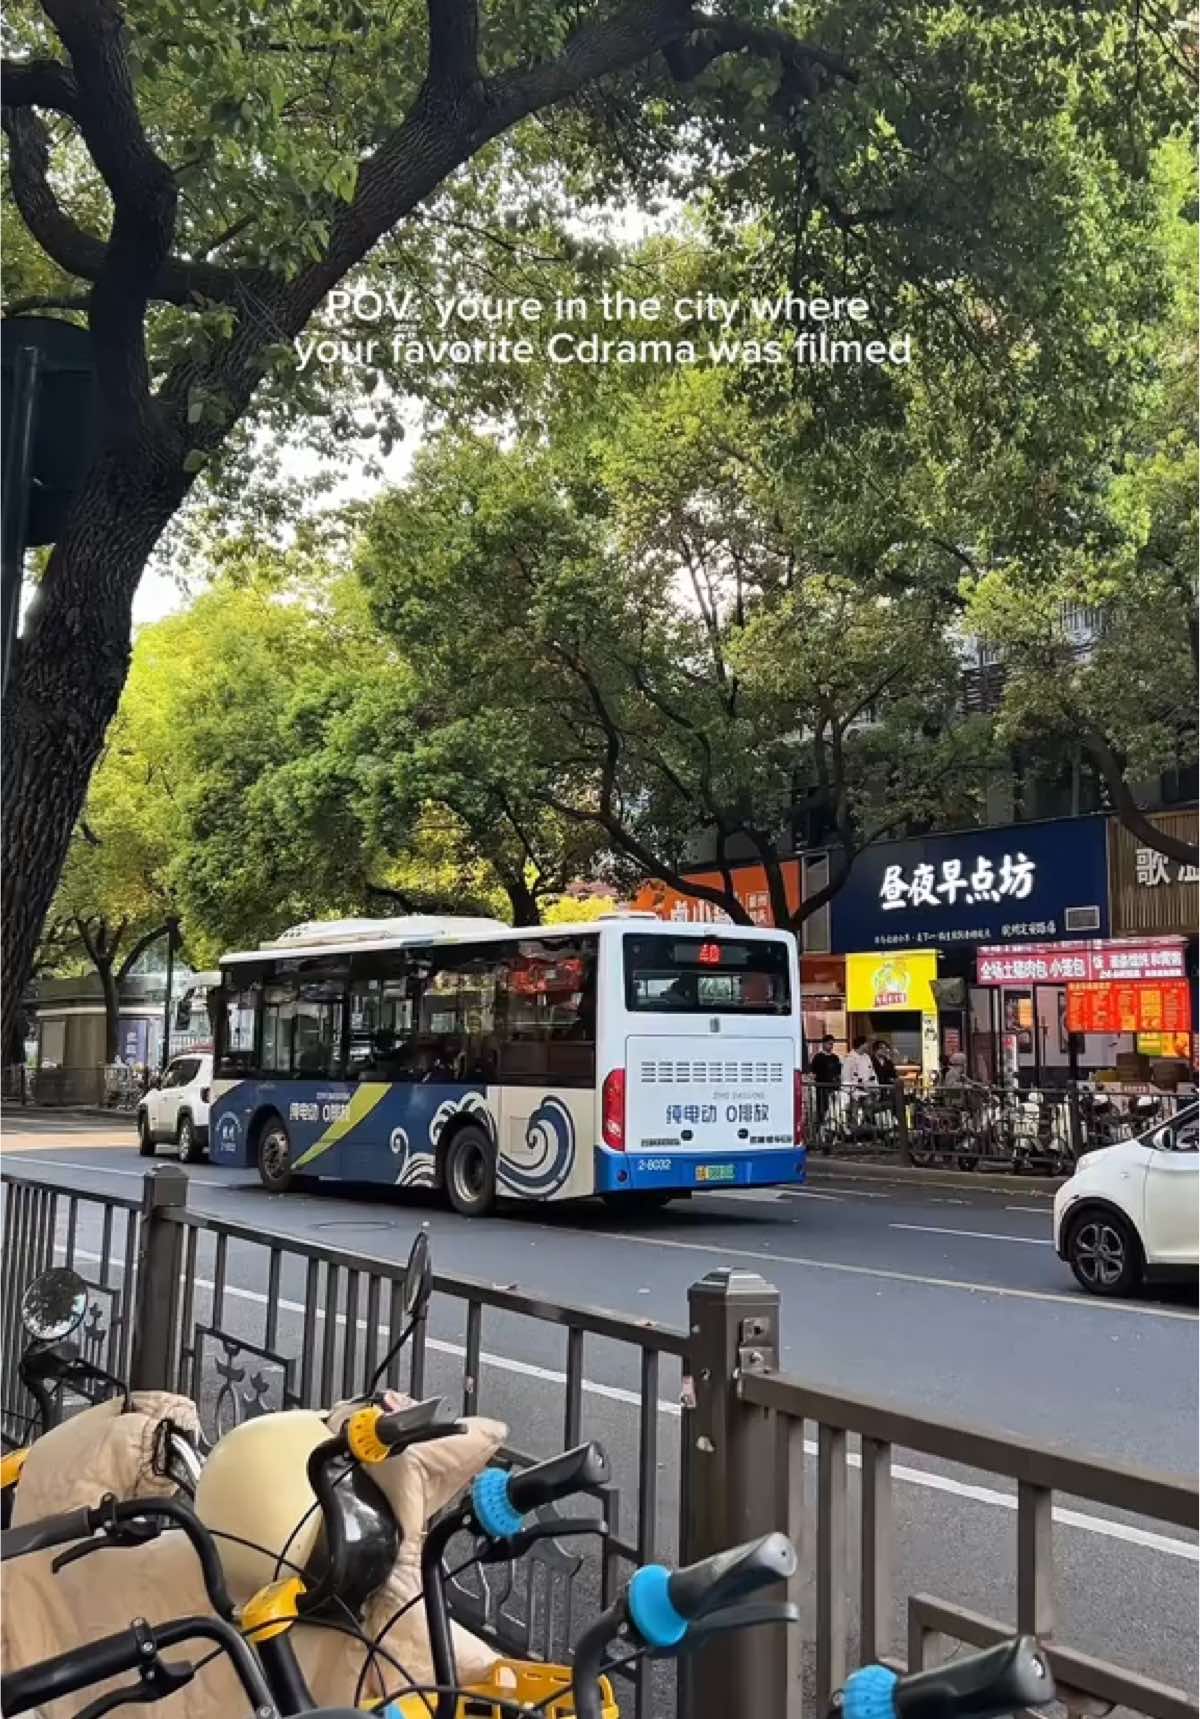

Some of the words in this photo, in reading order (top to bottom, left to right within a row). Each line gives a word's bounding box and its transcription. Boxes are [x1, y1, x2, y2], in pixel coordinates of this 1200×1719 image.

[879, 852, 1036, 911] 昼夜早点坊
[666, 1104, 718, 1125] 纯电动
